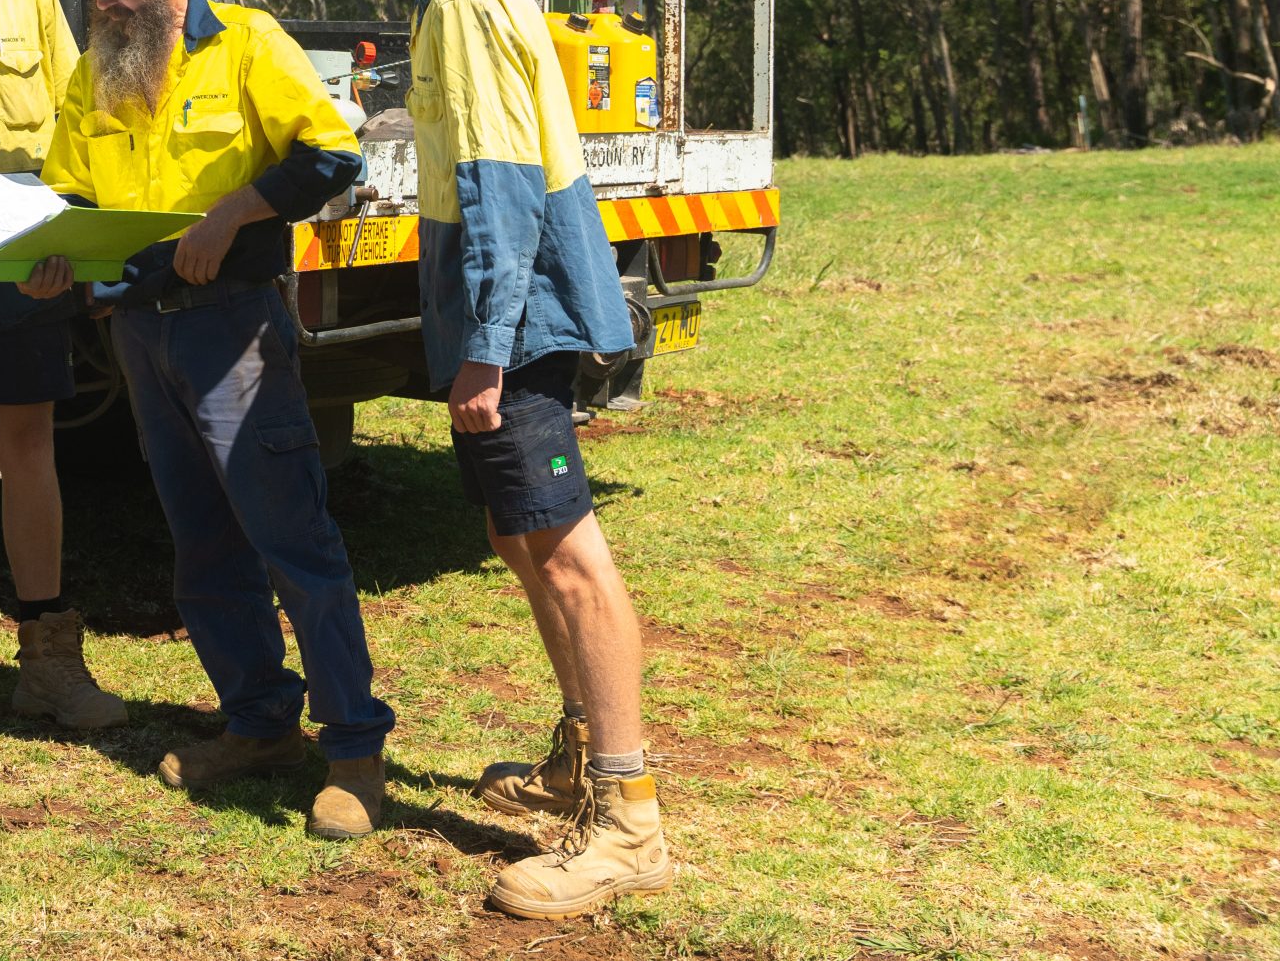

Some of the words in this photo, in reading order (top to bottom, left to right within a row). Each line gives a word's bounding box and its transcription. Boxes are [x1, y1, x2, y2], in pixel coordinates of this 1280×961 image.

[339, 223, 353, 242] NOT
[360, 240, 387, 262] VEHICLE
[554, 466, 568, 476] FXD
